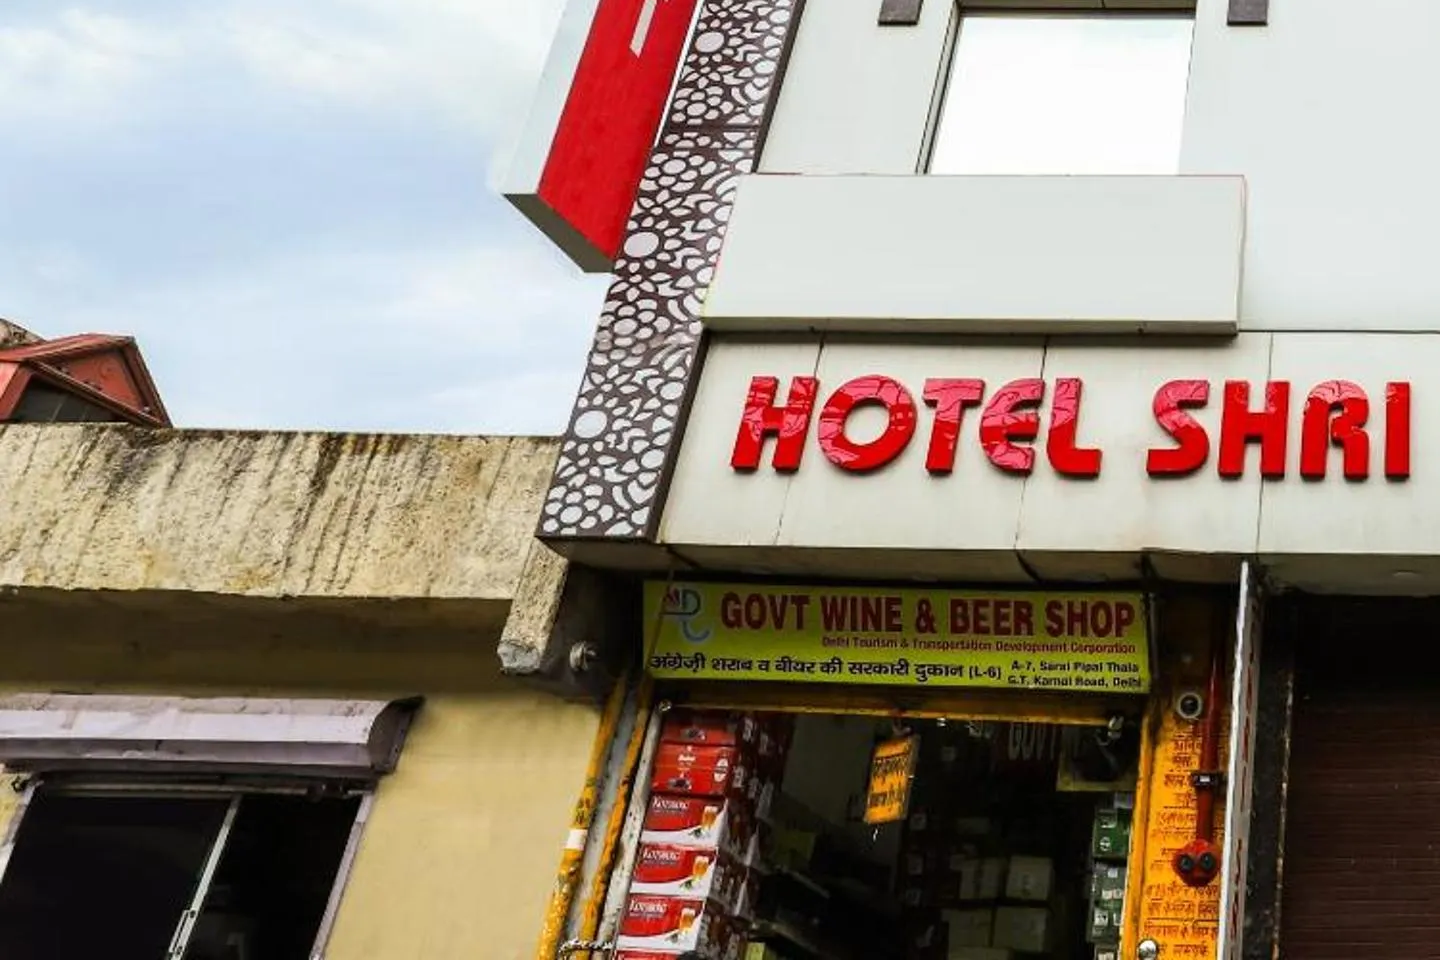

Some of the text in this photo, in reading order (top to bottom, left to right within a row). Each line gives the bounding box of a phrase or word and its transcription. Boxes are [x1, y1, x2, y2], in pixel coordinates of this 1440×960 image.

[730, 374, 1102, 478] HOTEL
[1146, 378, 1411, 483] SHRI
[721, 591, 1136, 638] GOVT WINE & BEER SHOP
[854, 638, 898, 650] Tourism
[912, 639, 992, 653] Transportation
[996, 641, 1067, 654] Development
[1070, 642, 1136, 655] Corporation
[914, 663, 964, 682] दुकान
